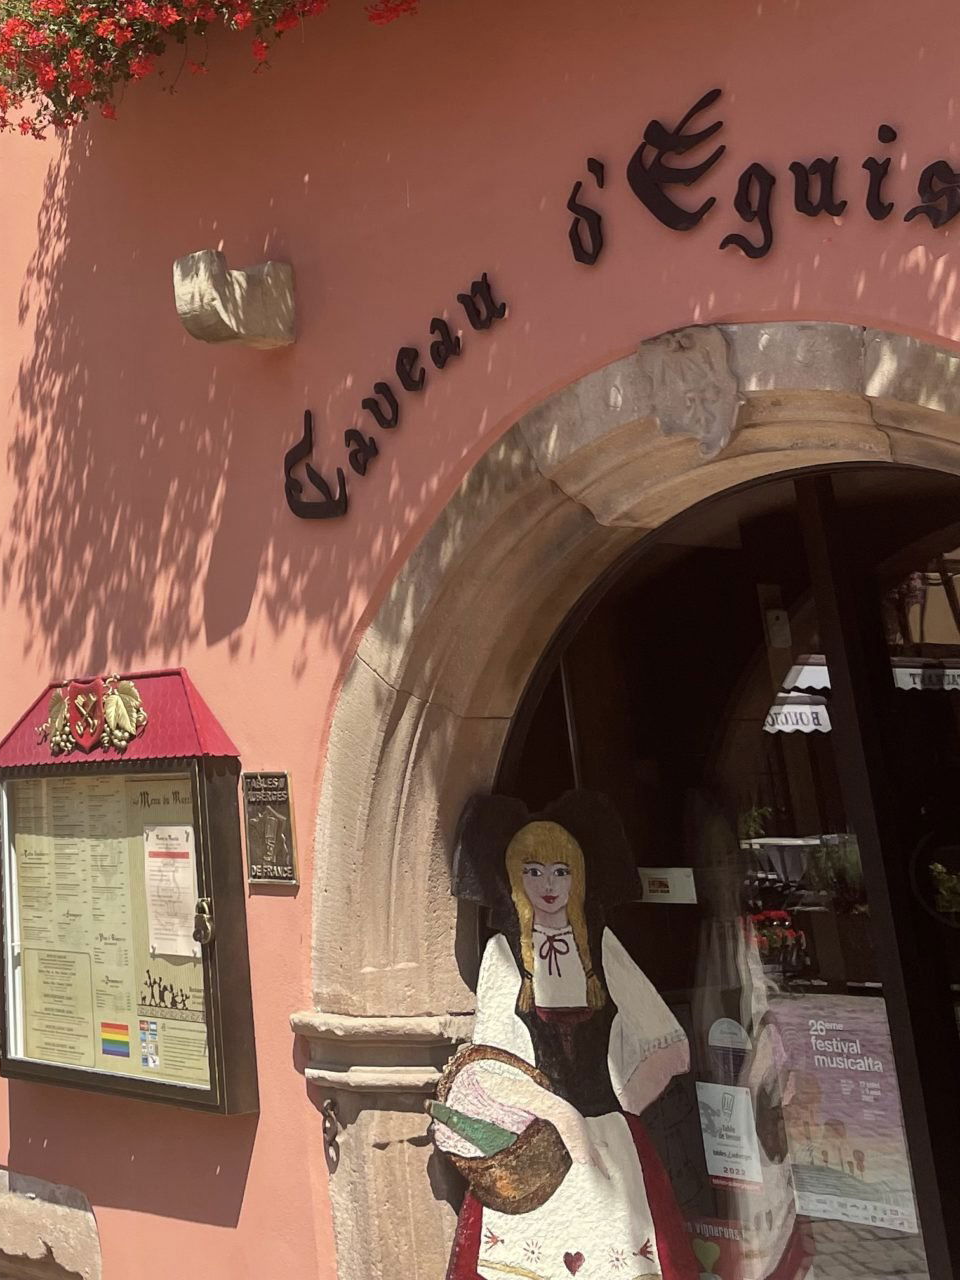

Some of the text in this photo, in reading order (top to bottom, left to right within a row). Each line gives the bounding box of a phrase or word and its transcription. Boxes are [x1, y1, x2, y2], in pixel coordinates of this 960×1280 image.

[283, 271, 509, 519] Caveau
[245, 777, 279, 789] TABLES
[248, 790, 288, 801] AUBERGES
[251, 865, 294, 877] DE FRANCE
[810, 1036, 861, 1055] festival
[814, 1054, 884, 1073] musicalta
